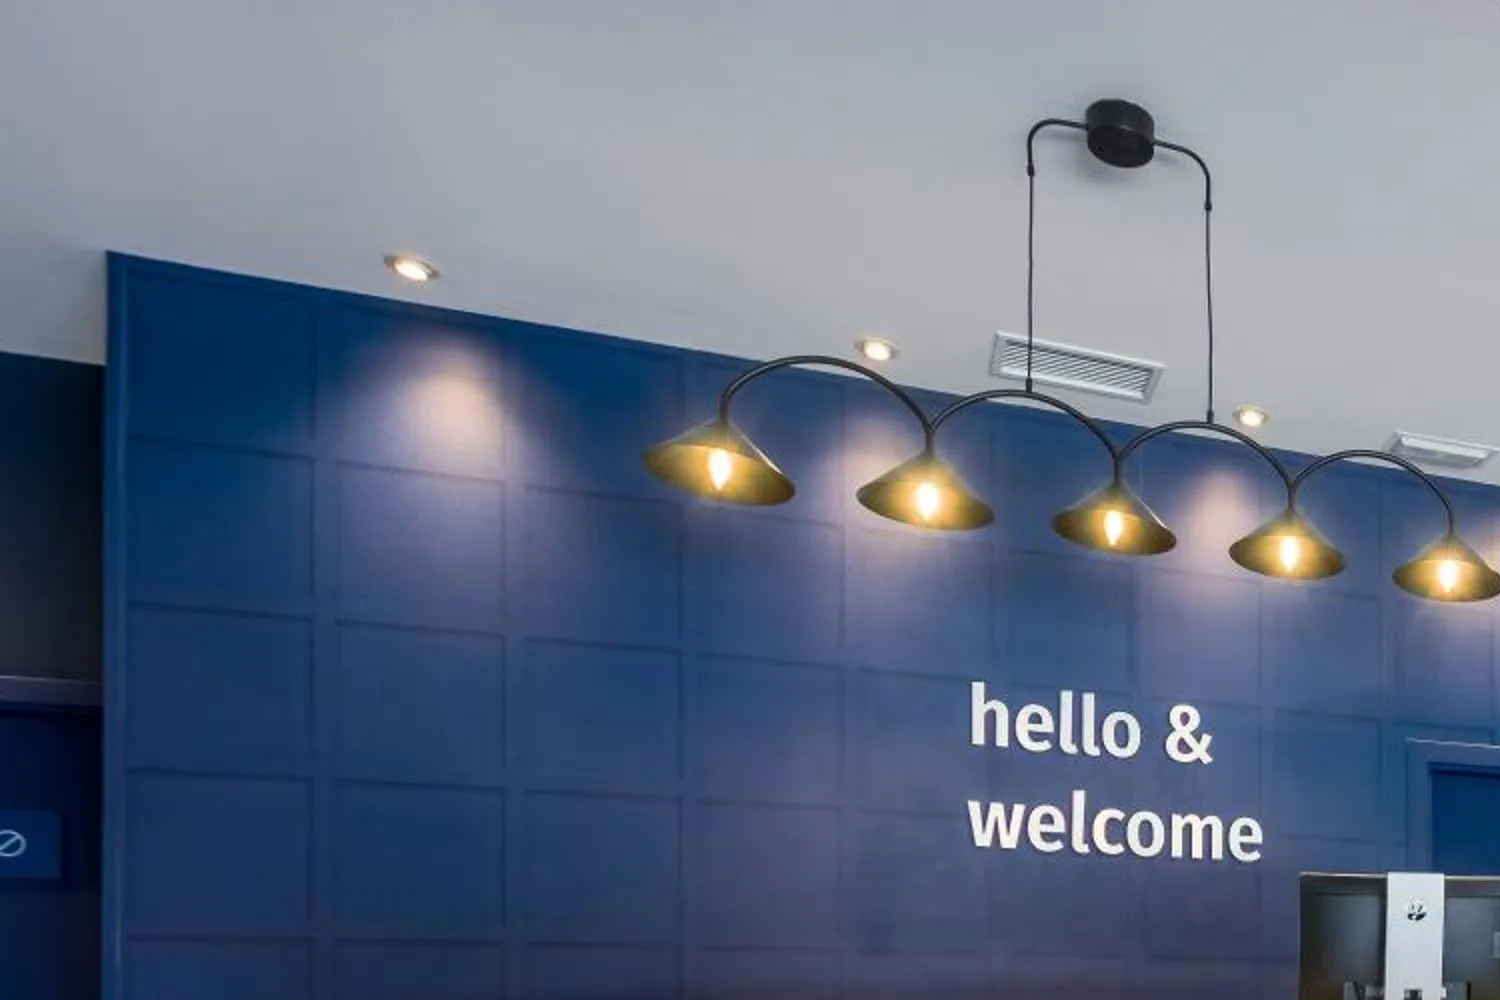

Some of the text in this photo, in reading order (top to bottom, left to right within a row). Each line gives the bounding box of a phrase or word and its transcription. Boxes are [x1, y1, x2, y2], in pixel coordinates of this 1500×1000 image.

[971, 681, 1213, 765] hello &
[967, 789, 1263, 863] welcome
